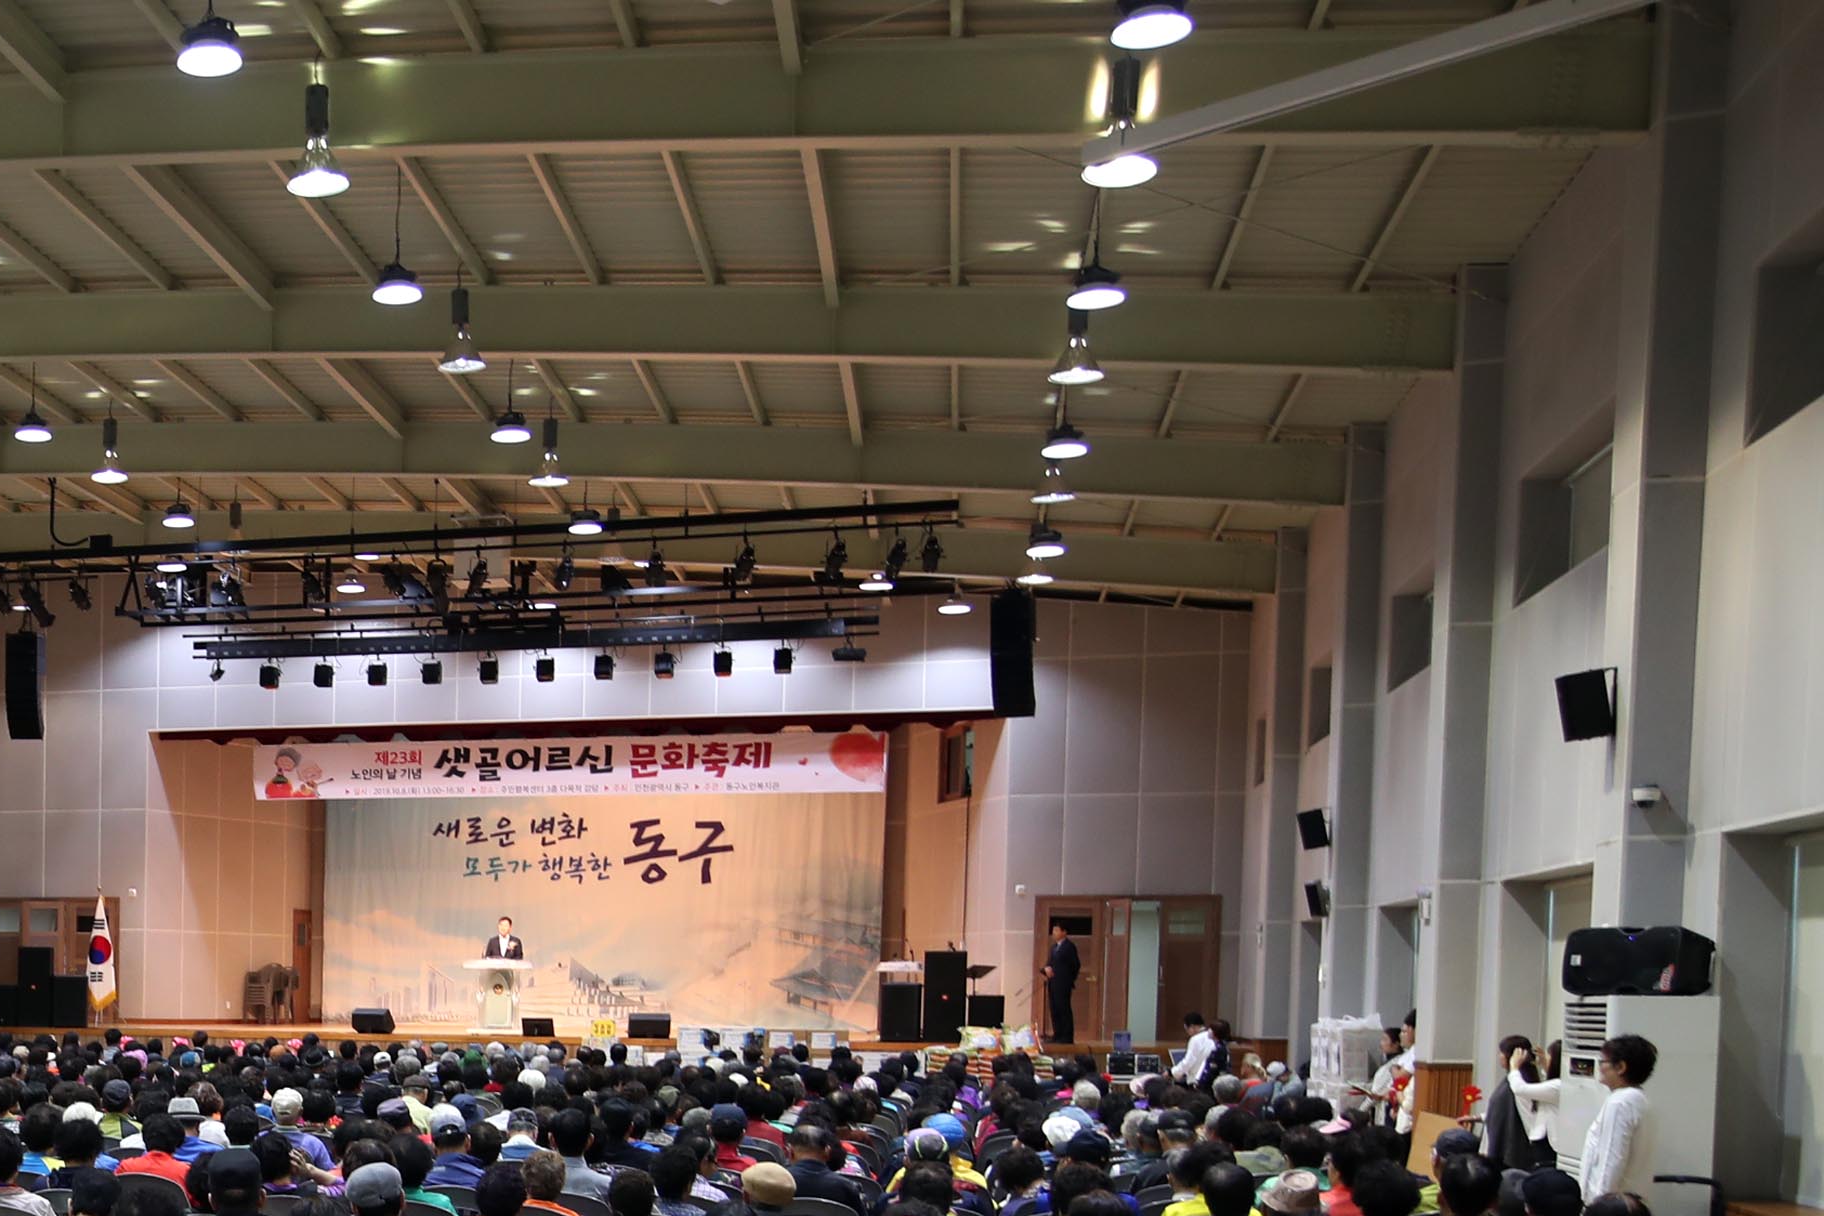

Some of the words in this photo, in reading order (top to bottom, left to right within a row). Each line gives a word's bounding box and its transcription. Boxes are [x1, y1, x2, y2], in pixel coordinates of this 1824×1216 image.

[350, 768, 383, 780] 노인의
[386, 768, 397, 780] 날
[400, 767, 422, 780] 기념
[375, 750, 422, 766] 제23회
[434, 745, 614, 781] 샛골어르신
[630, 742, 772, 778] 문화축제
[432, 816, 517, 848] 새로운
[530, 812, 588, 847] 변화
[463, 856, 533, 882] 모두가
[538, 852, 613, 885] 행복한
[623, 818, 735, 885] 동구
